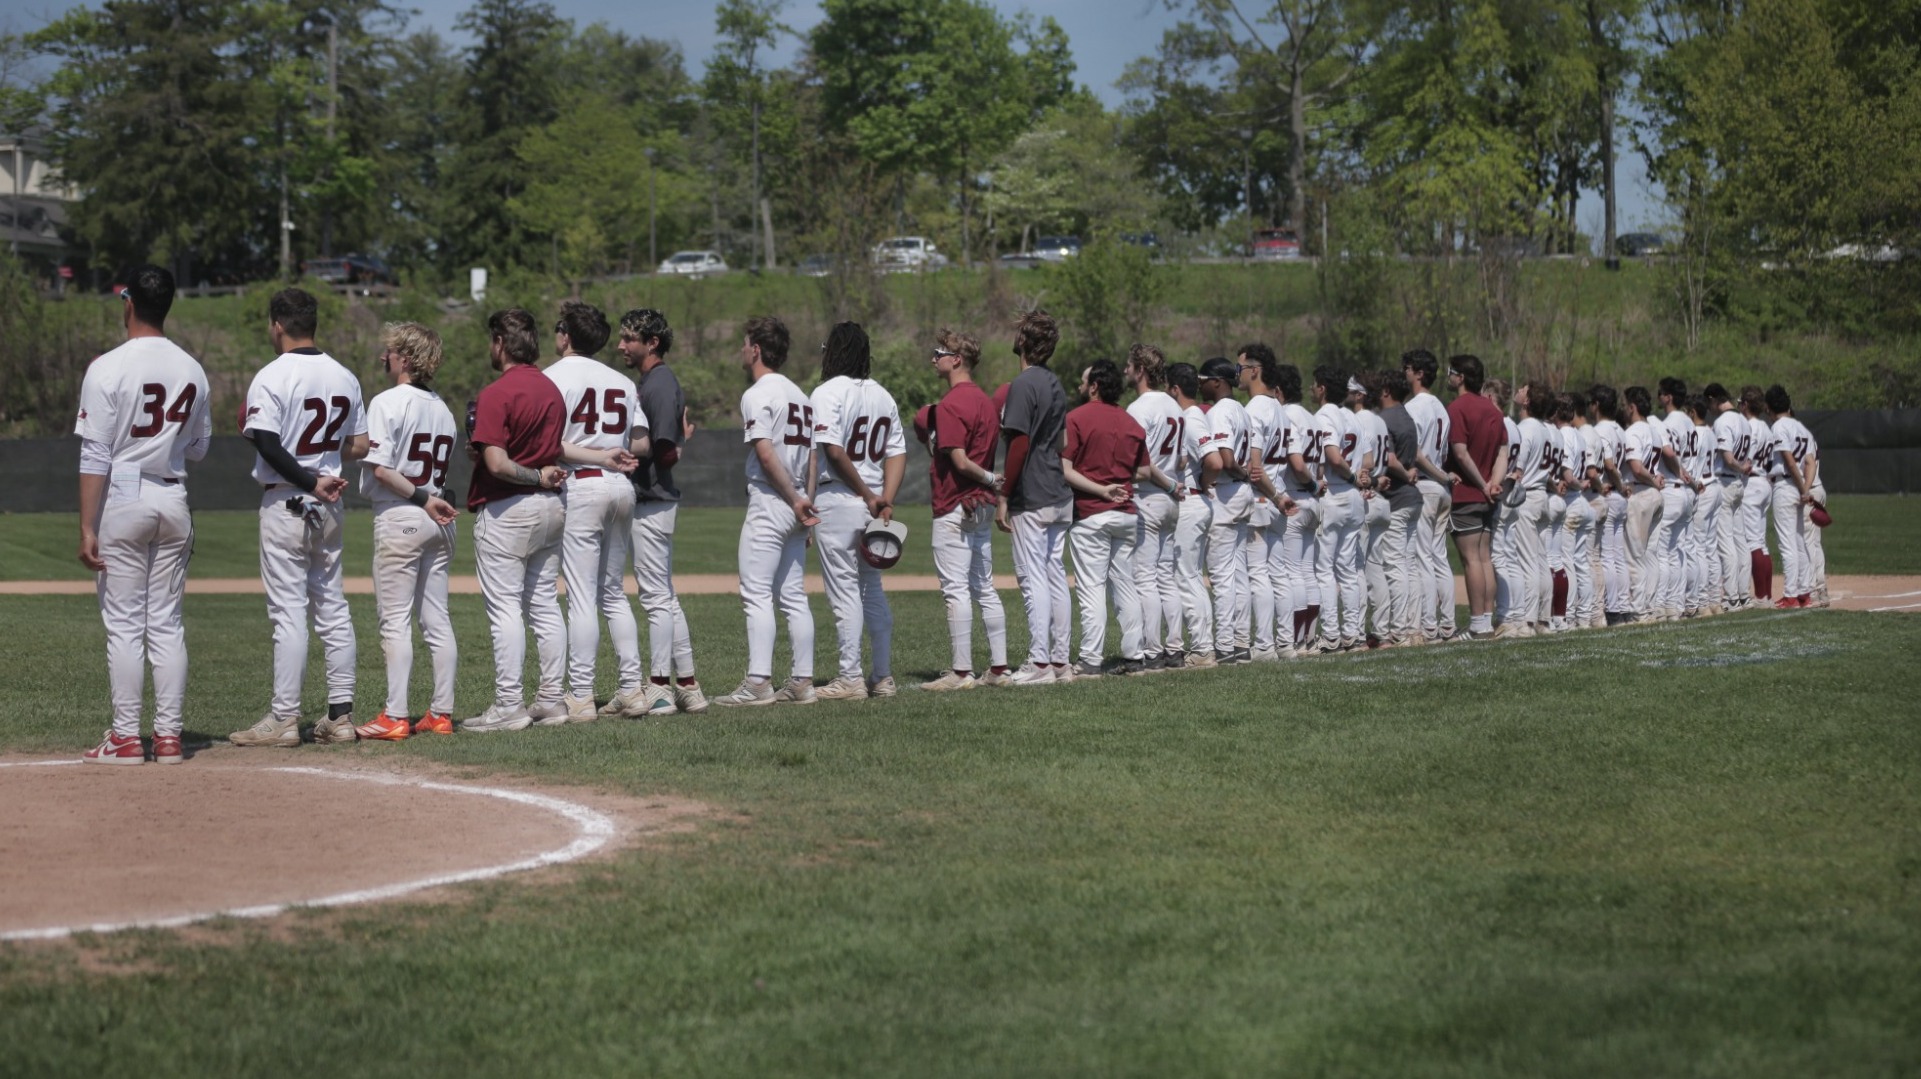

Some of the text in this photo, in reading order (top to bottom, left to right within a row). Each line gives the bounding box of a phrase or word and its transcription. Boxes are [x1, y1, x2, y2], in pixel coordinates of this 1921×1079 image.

[131, 382, 197, 438] 34
[296, 395, 350, 456] 22
[570, 387, 628, 435] 45
[402, 432, 453, 487] 59
[845, 415, 891, 462] 60
[1160, 417, 1185, 456] 21
